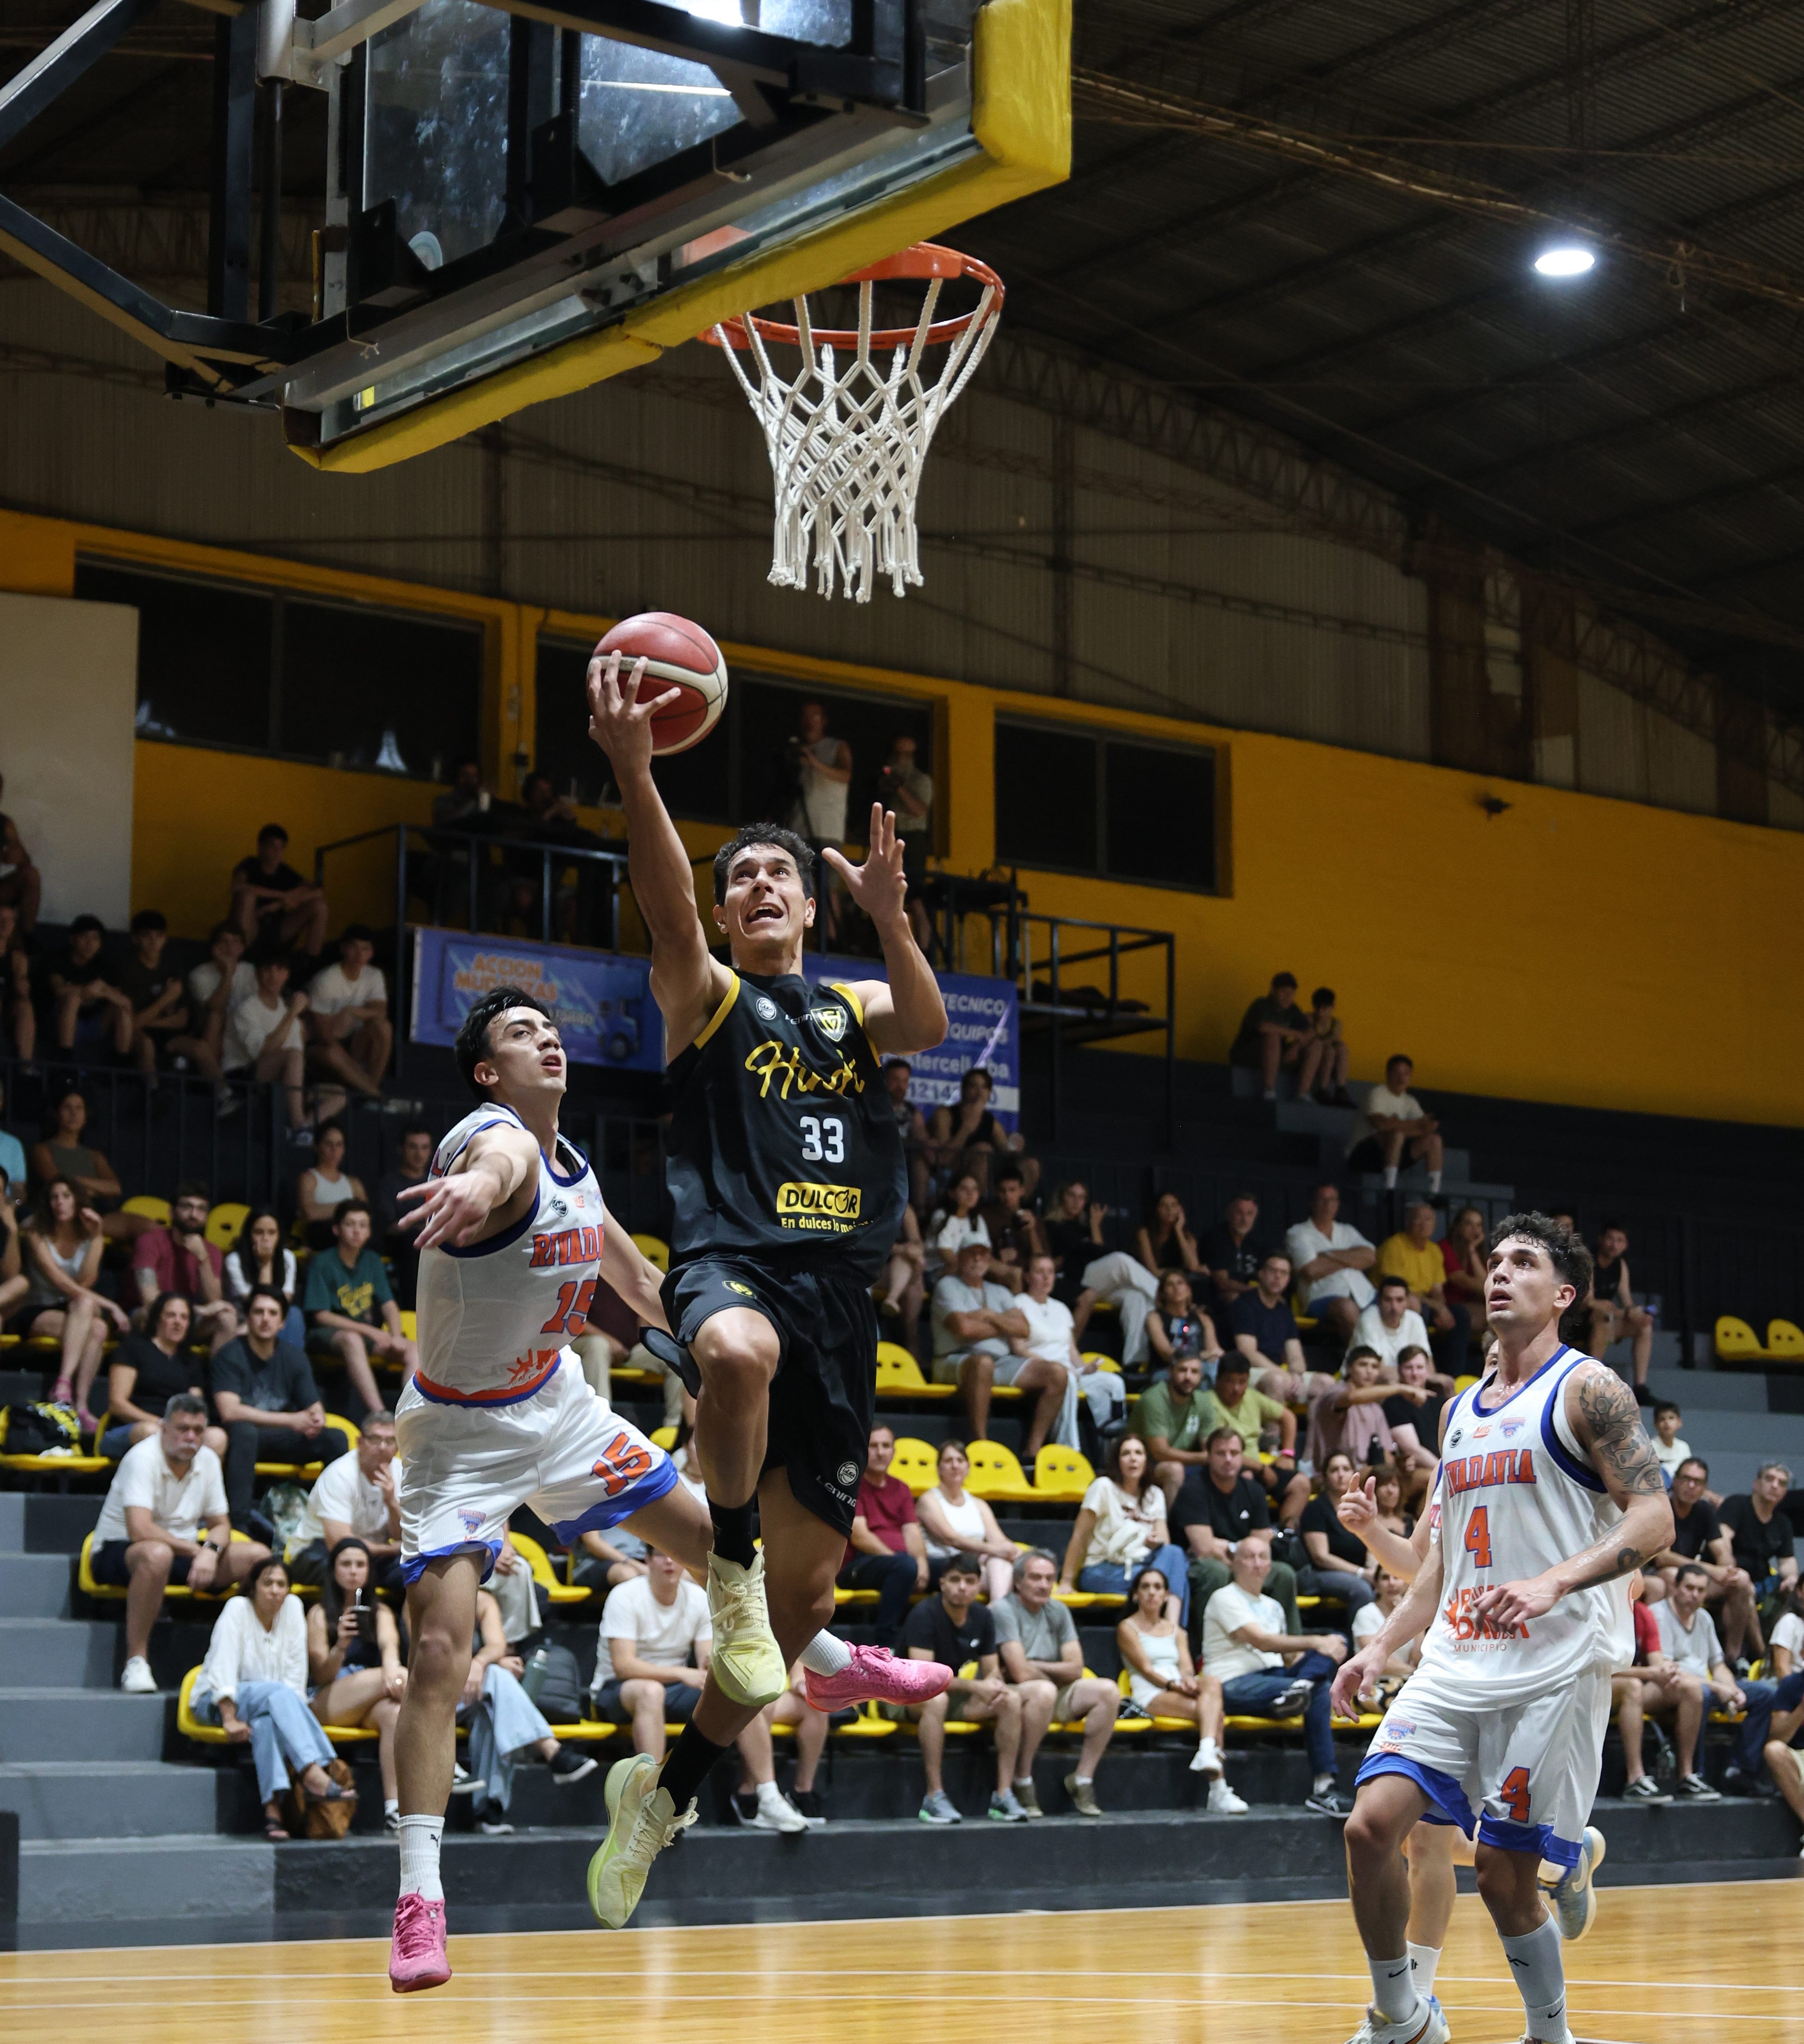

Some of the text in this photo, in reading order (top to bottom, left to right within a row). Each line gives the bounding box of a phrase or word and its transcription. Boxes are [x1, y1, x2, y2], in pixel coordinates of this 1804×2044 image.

[474, 953, 543, 979] ACCION
[455, 971, 558, 1002] MUDZAS
[947, 1022, 1009, 1045] QUIPOS
[800, 1116, 845, 1163] 33
[786, 1189, 857, 1213] DULCOR
[781, 1217, 795, 1228] En
[799, 1216, 832, 1230] dulces
[833, 1218, 839, 1232] lo
[540, 1279, 598, 1336] 15
[1474, 1425, 1493, 1436] MIG
[590, 1430, 653, 1497] 15
[1445, 1449, 1537, 1499] IVADAVIA
[1464, 1505, 1492, 1569] 4
[1454, 1643, 1507, 1652] MUNICIPIO
[1500, 1766, 1531, 1823] 4
